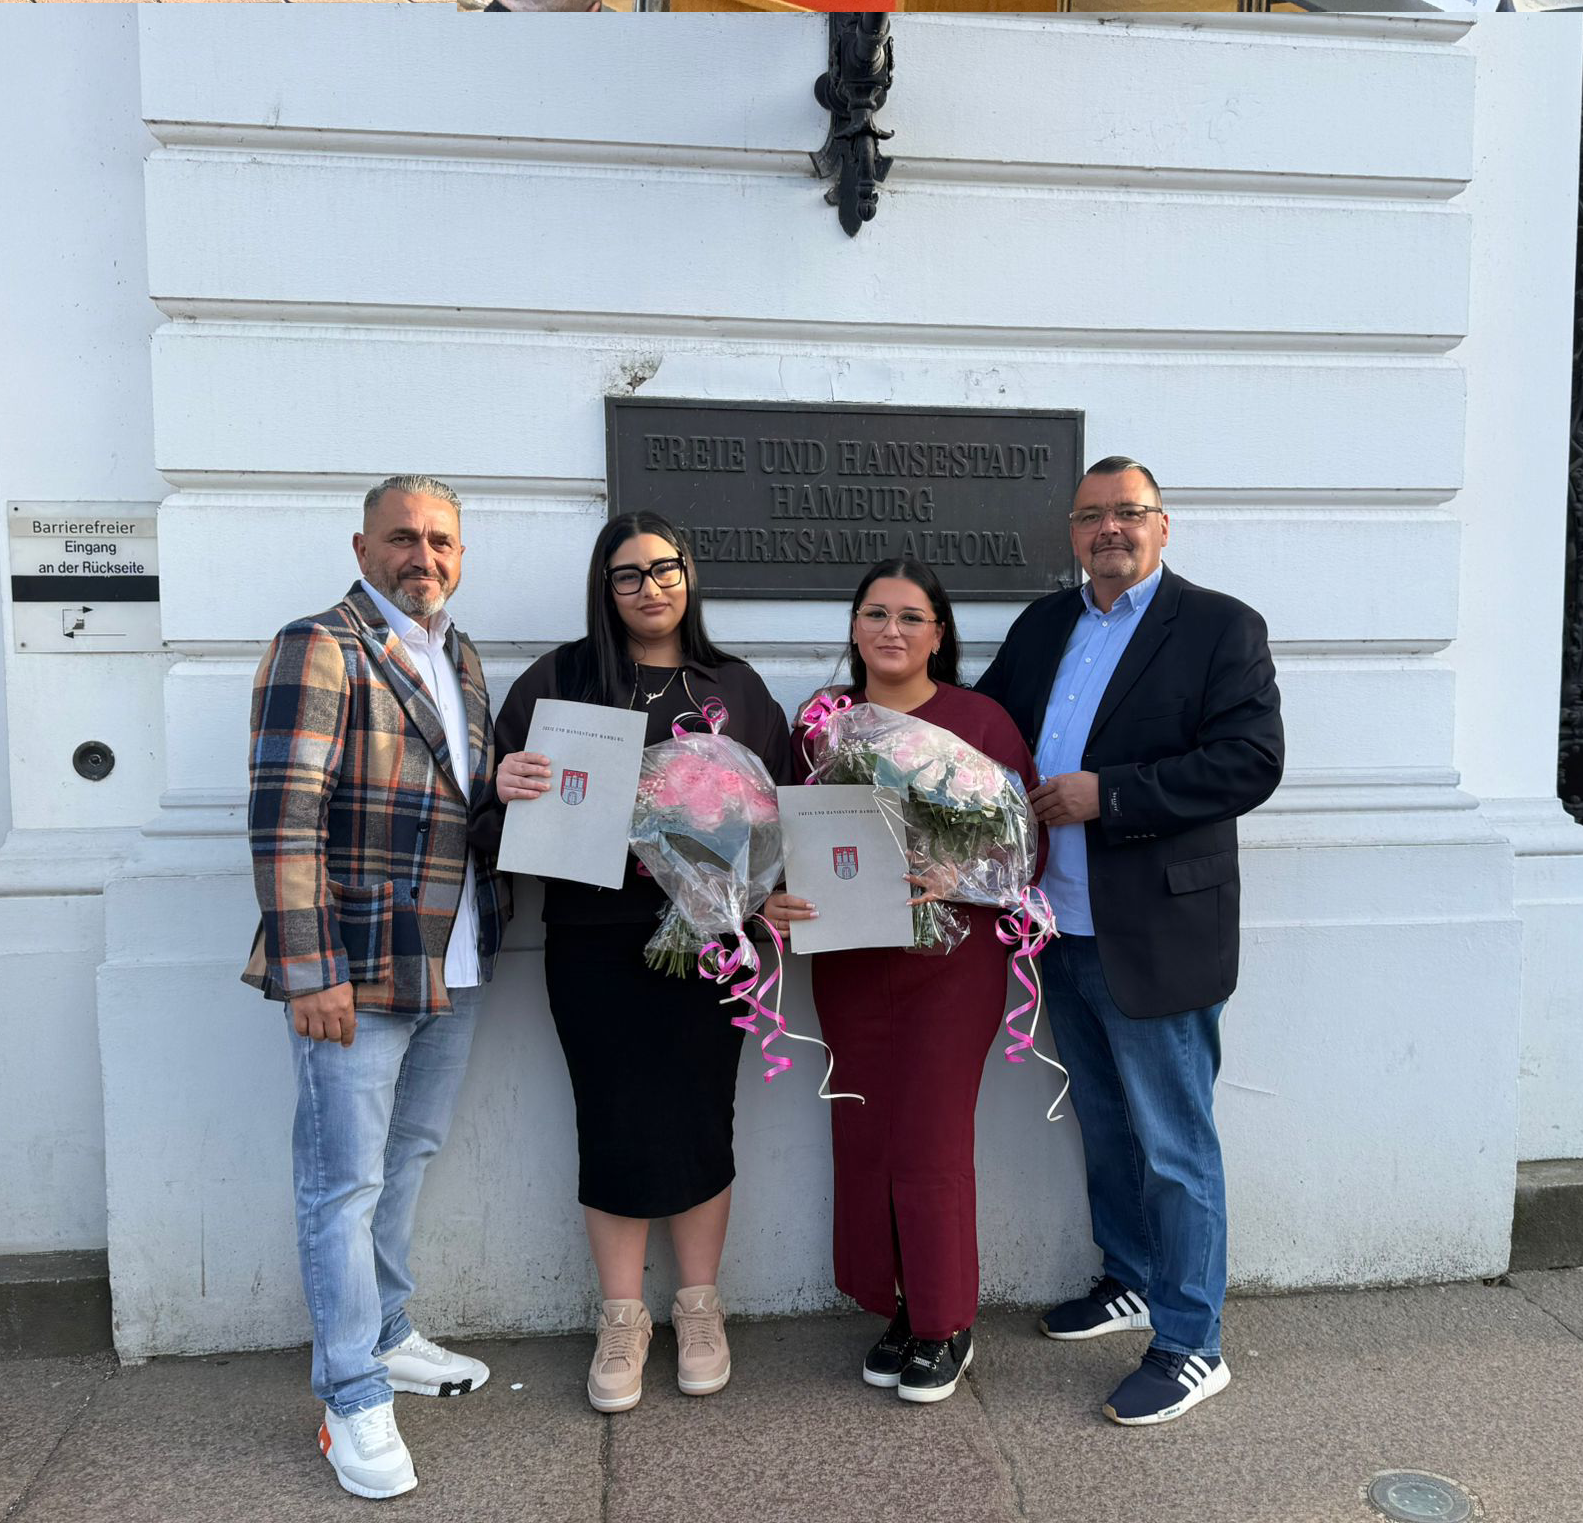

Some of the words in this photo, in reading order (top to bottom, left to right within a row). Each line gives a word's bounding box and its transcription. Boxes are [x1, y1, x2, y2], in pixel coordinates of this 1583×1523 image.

[644, 434, 746, 473] FREIE
[758, 437, 827, 476] UND
[837, 440, 1051, 480] HANSESTADT
[770, 483, 935, 523] HAMBURG
[32, 520, 136, 534] Barrierefreier
[65, 540, 117, 555] Eingang
[902, 530, 1027, 567] ALTONA
[38, 563, 54, 574] an
[58, 561, 79, 574] der
[82, 560, 145, 574] Rückseite
